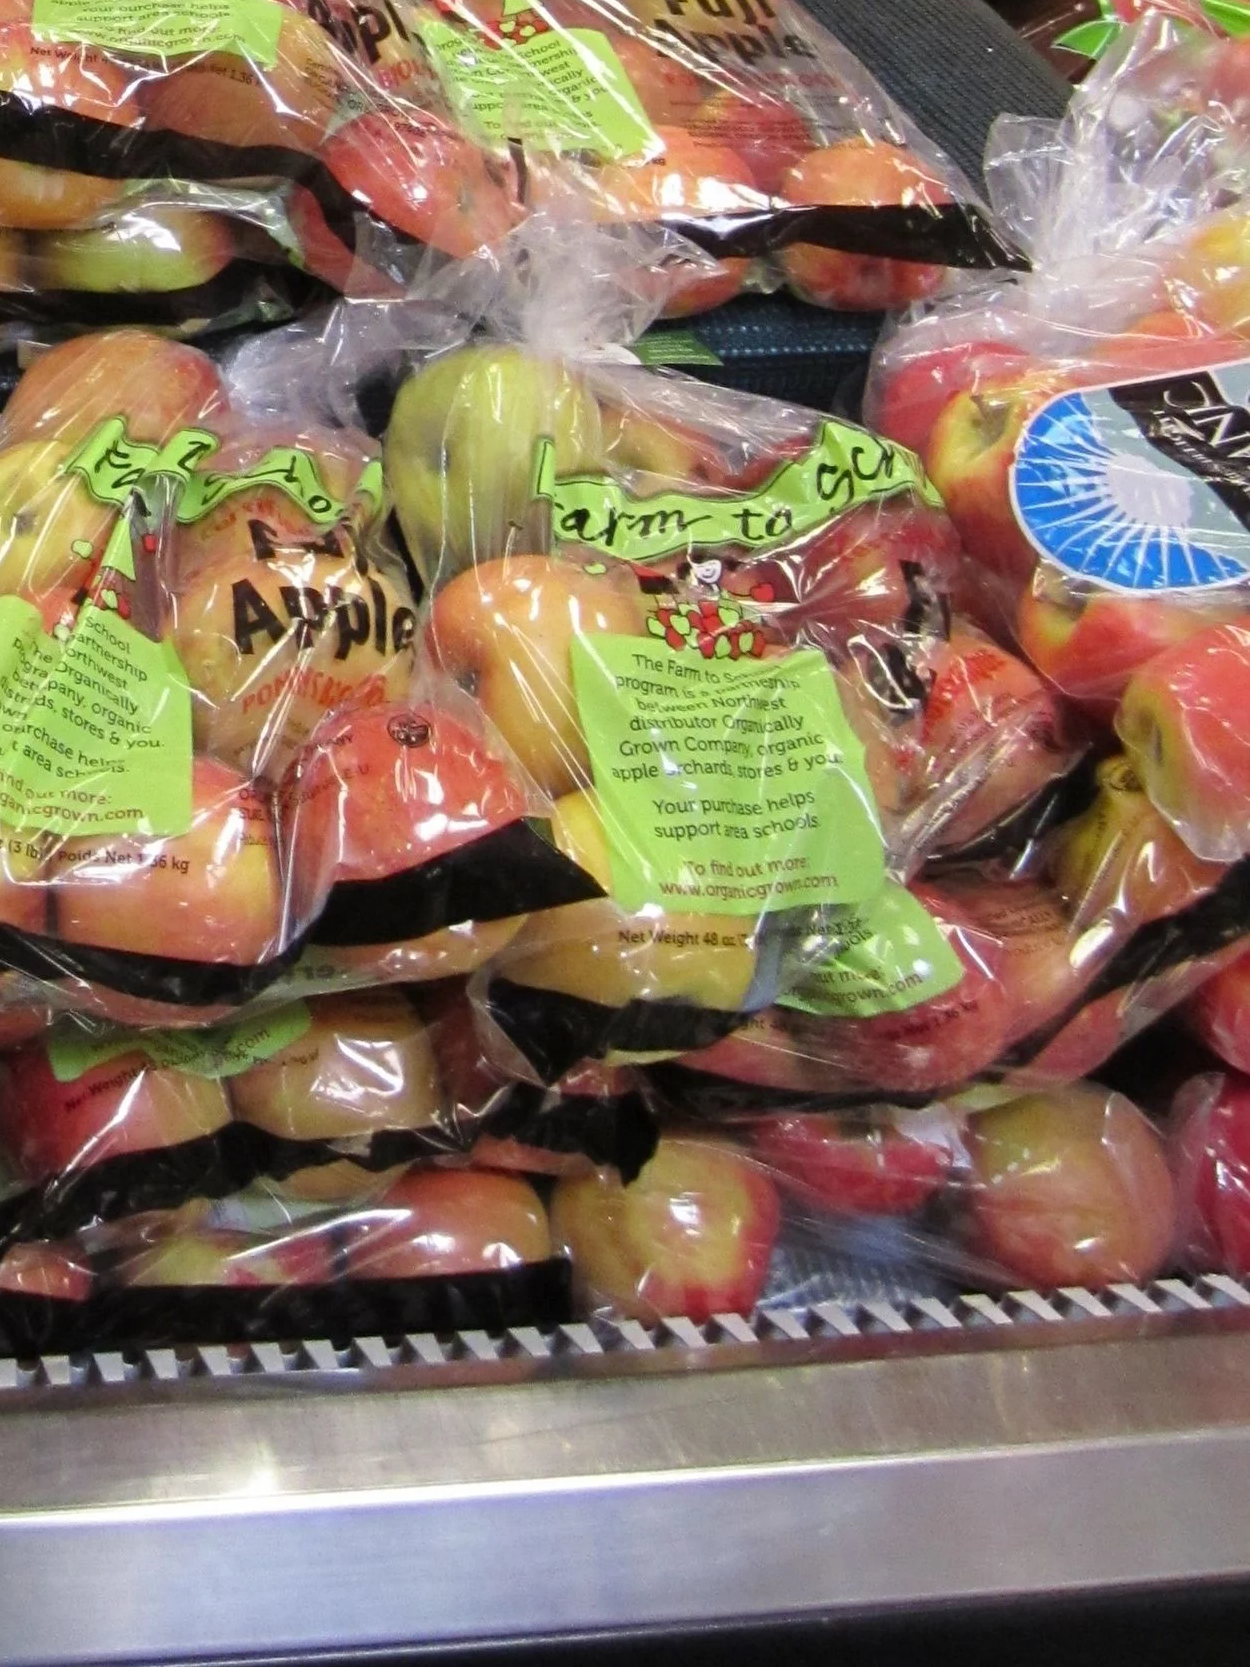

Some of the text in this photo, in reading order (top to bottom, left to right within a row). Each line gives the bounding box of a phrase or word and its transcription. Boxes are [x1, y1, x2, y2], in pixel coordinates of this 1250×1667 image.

[552, 502, 795, 547] arm to
[632, 653, 664, 674] The
[667, 658, 701, 681] Farm
[704, 670, 720, 685] to
[616, 674, 696, 699] program is
[636, 693, 787, 714] between Northwest
[629, 713, 804, 735] distributor Organically
[619, 738, 680, 758] Grown
[756, 733, 825, 758] organic
[611, 762, 659, 783] apple
[737, 762, 783, 780] stores
[787, 757, 800, 772] &
[652, 789, 816, 820] Your purchase helps
[653, 821, 720, 843] support
[723, 824, 749, 840] area
[685, 858, 707, 876] To
[710, 858, 733, 876] find
[735, 861, 763, 878] out
[659, 874, 839, 903] www.organicgrown.com
[617, 929, 700, 948] Net Weight
